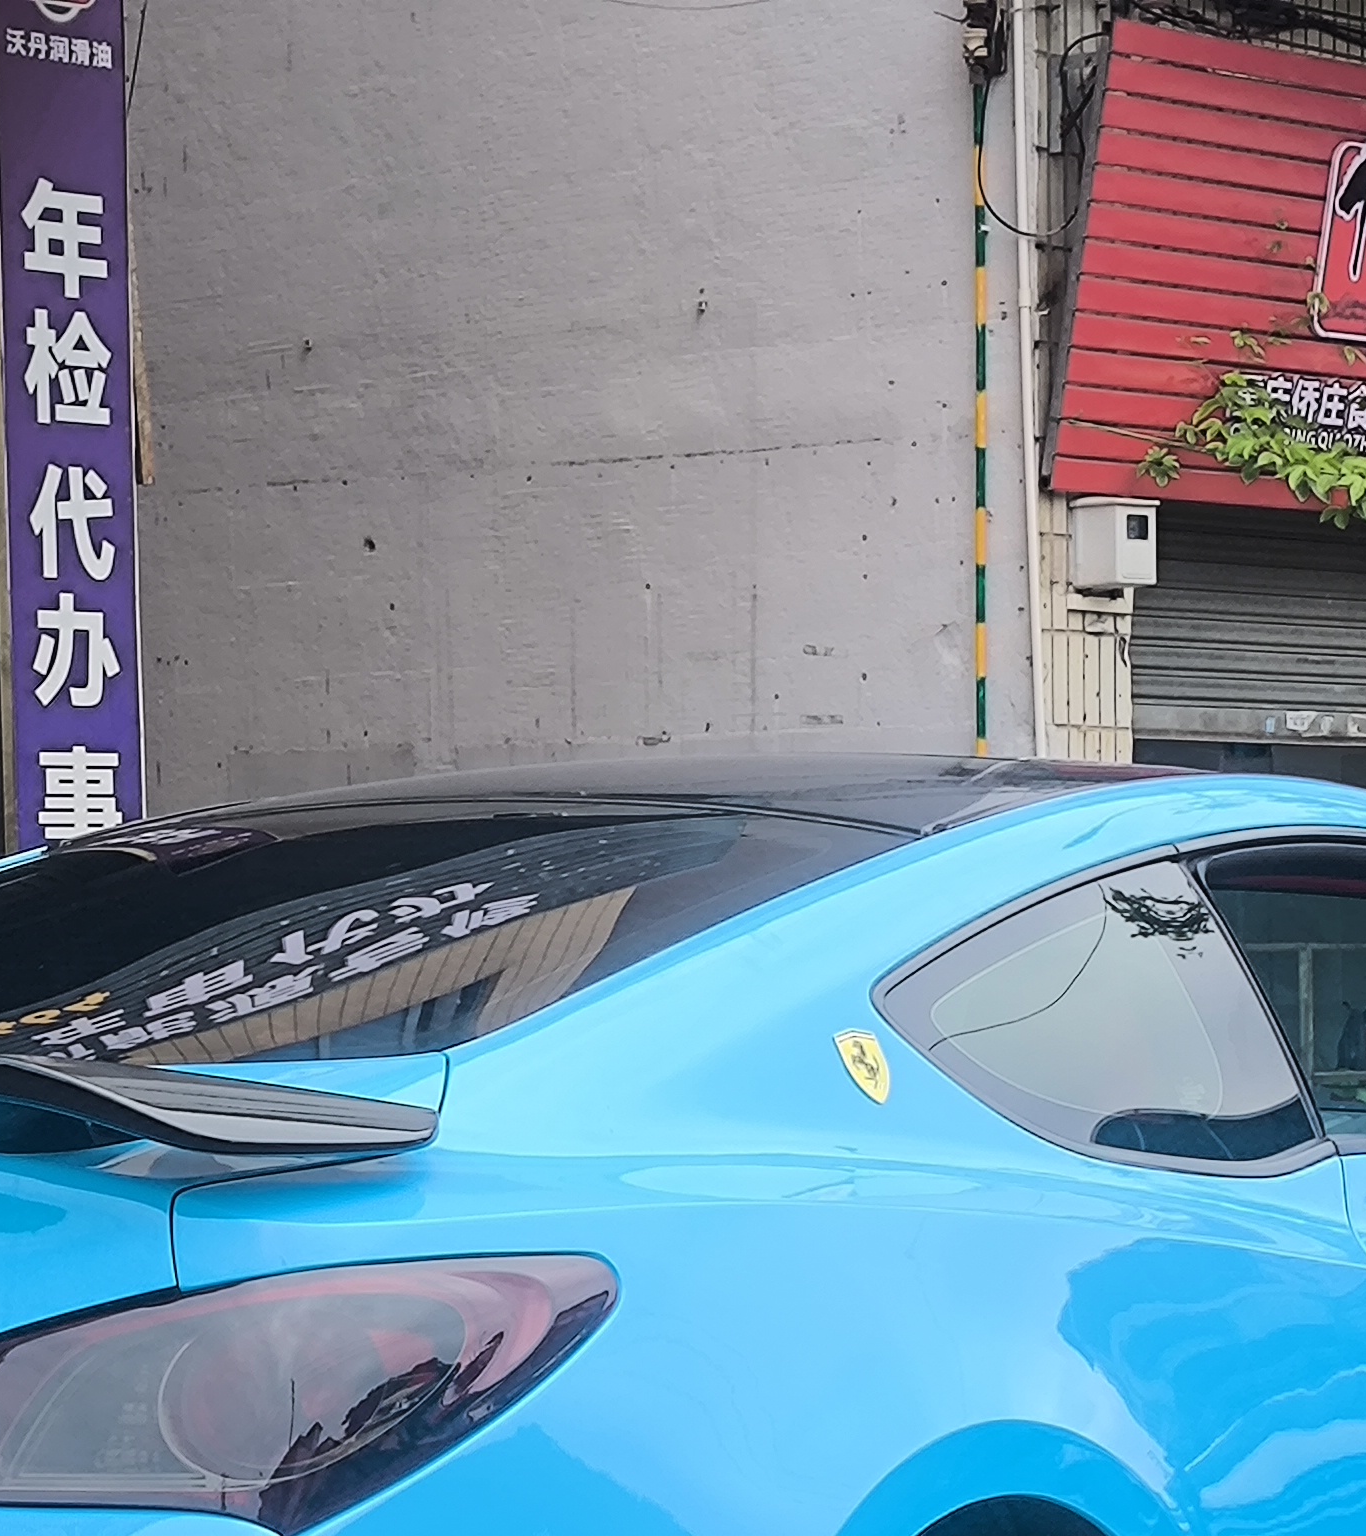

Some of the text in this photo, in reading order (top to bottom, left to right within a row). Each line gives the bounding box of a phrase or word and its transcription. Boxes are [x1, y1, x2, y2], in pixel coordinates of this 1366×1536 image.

[5, 27, 113, 70] 沃丹润滑油
